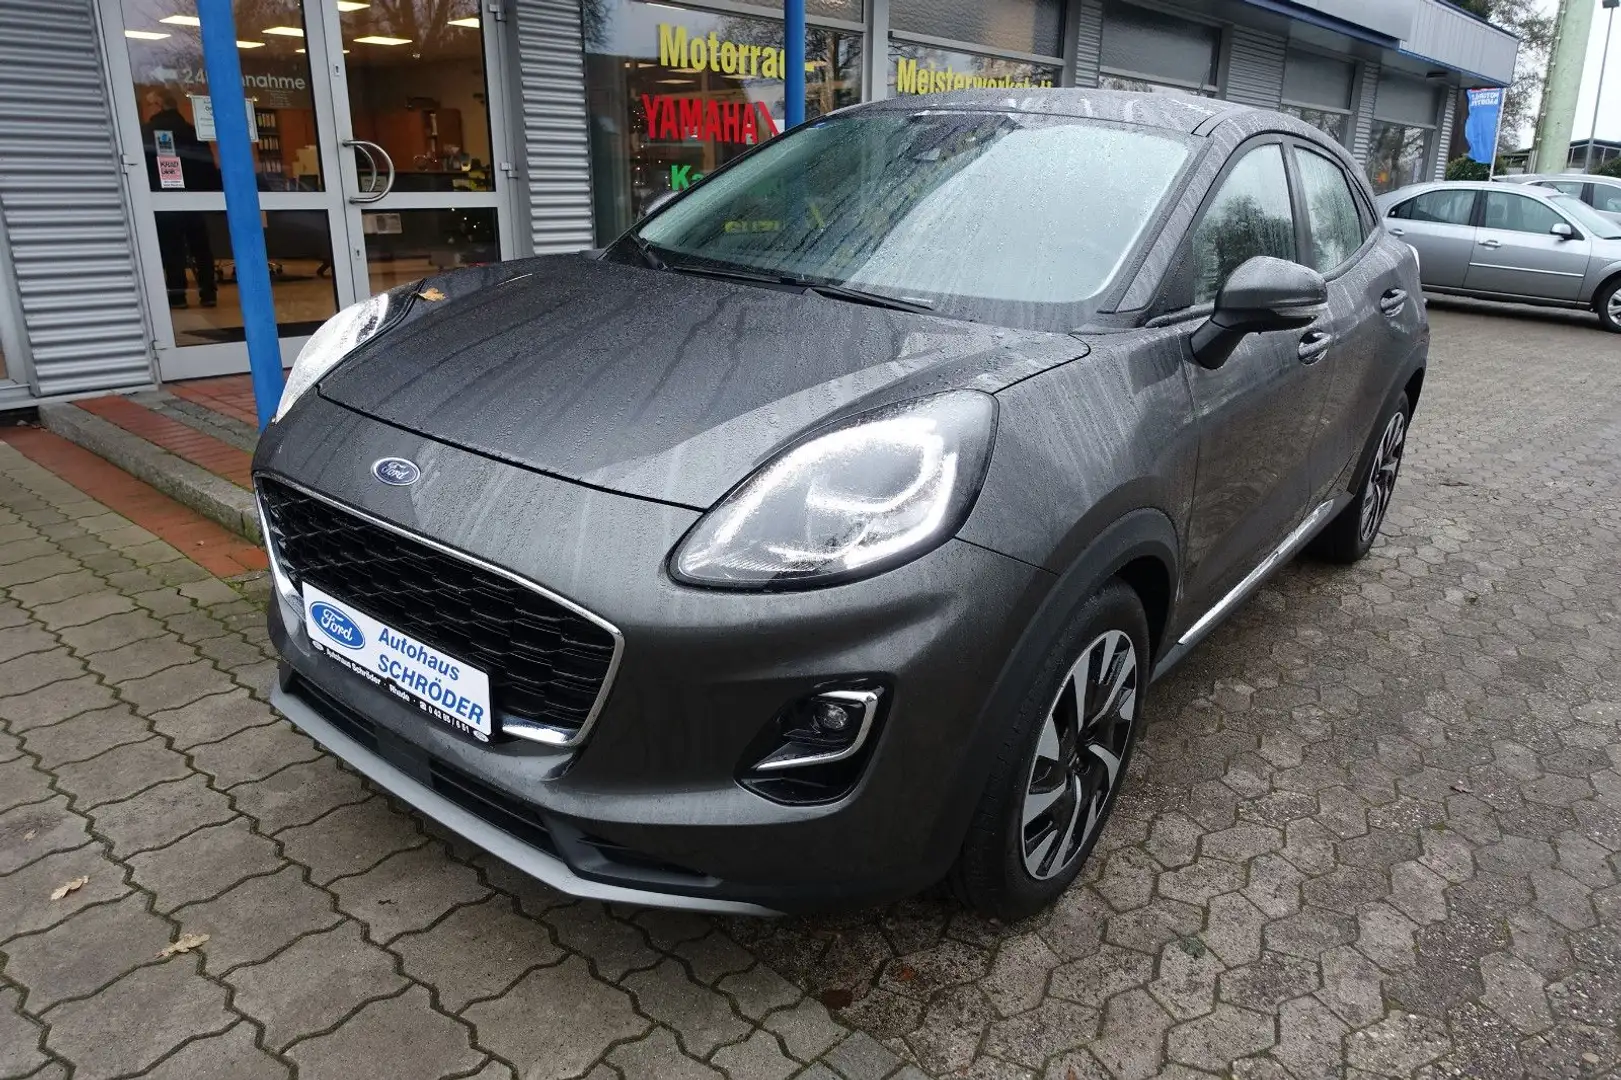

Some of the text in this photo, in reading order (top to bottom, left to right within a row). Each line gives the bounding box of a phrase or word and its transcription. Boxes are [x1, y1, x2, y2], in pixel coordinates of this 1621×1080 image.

[658, 23, 815, 80] Motorra-
[641, 93, 759, 144] YAMAHA
[378, 628, 461, 681] Autohaus
[377, 654, 485, 725] SCHRÖDER
